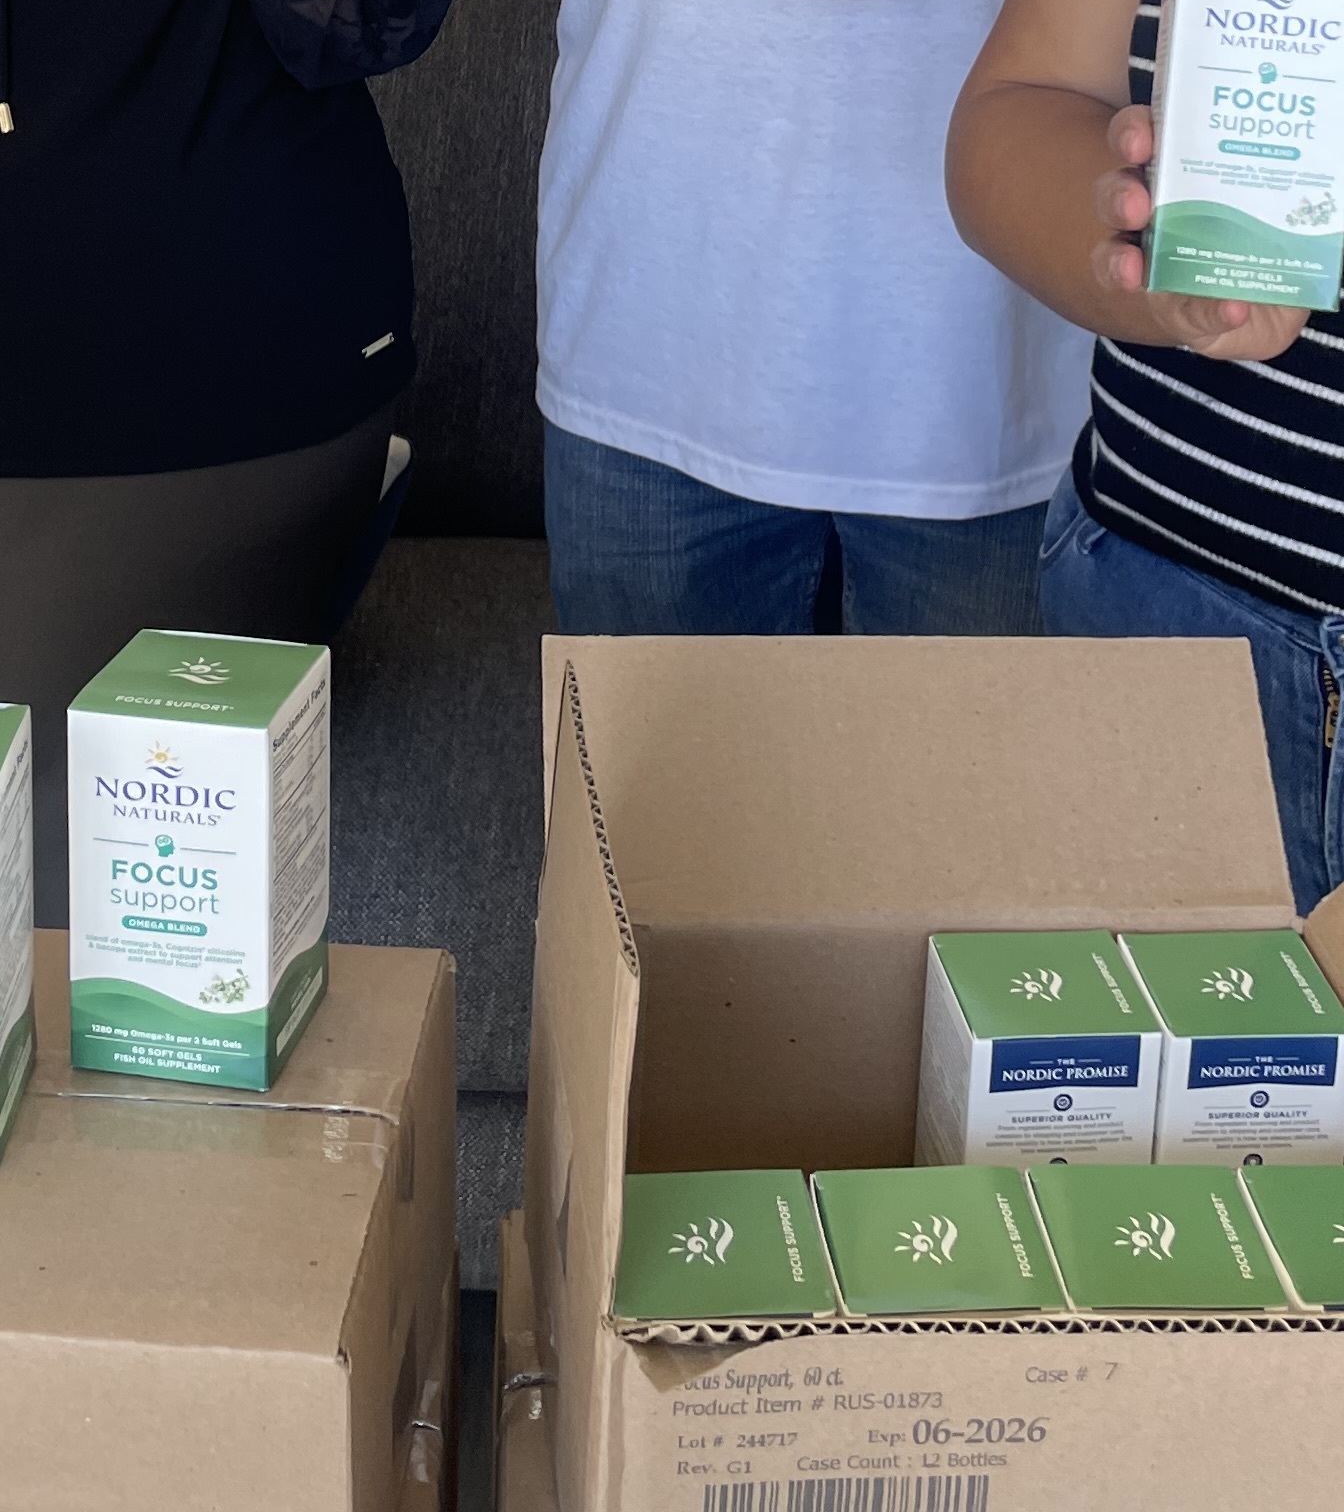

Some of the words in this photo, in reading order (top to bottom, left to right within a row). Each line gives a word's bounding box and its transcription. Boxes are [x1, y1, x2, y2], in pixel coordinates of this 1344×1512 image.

[1205, 7, 1342, 41] NORDIC
[1220, 33, 1324, 56] NATURALS
[1212, 85, 1316, 117] FOCUS
[1209, 112, 1316, 139] support
[115, 695, 161, 706] FOCUS
[165, 699, 230, 711] SUPPORT
[95, 776, 236, 810] NORDIC
[113, 804, 219, 826] NATURALS
[111, 859, 218, 890] FOCUS
[110, 888, 219, 915] support
[128, 918, 165, 930] OMEGA
[167, 923, 201, 934] BLEND
[114, 1053, 136, 1063] FISH
[138, 1056, 154, 1066] OIL
[157, 1058, 221, 1073] SUPPLEMENT
[132, 1046, 145, 1055] 60
[148, 1048, 174, 1058] SOFT
[177, 1051, 202, 1061] GELS
[1002, 1068, 1063, 1082] NORDIC
[1066, 1065, 1129, 1080] PROMISE
[1200, 1065, 1260, 1079] NORDIC
[1263, 1064, 1326, 1077] PROMISE
[1011, 1114, 1064, 1124] SUPERIOR
[1067, 1112, 1112, 1122] QUALITY
[1208, 1111, 1260, 1119] SUPERIOR
[1264, 1110, 1308, 1119] QUALITY
[777, 1196, 797, 1247] SUPPORT
[996, 1193, 1023, 1243] SUPPORT
[1211, 1194, 1239, 1243] SUPPORT
[787, 1247, 805, 1283] FOCUS
[1010, 1241, 1034, 1278] FOCUS
[1231, 1244, 1254, 1280] FOCUS
[725, 1369, 794, 1395] Support,
[803, 1366, 822, 1386] 60
[826, 1367, 844, 1386] ct.
[1025, 1366, 1069, 1383] Case
[1075, 1366, 1088, 1382] #
[1105, 1362, 1118, 1380] 7
[673, 1399, 749, 1416] Product
[755, 1397, 802, 1414] Item
[811, 1395, 824, 1411] #
[833, 1391, 943, 1410] RUS-01873
[678, 1435, 706, 1449] Lot
[713, 1435, 723, 1447] #
[736, 1432, 798, 1448] 244717
[868, 1429, 906, 1447] Exp:
[912, 1416, 1050, 1445] 06-2026
[677, 1460, 717, 1475] Rev.
[726, 1460, 752, 1474] G1
[797, 1455, 841, 1471] Case
[847, 1453, 900, 1470] Count
[947, 1451, 1007, 1467] Bottles
